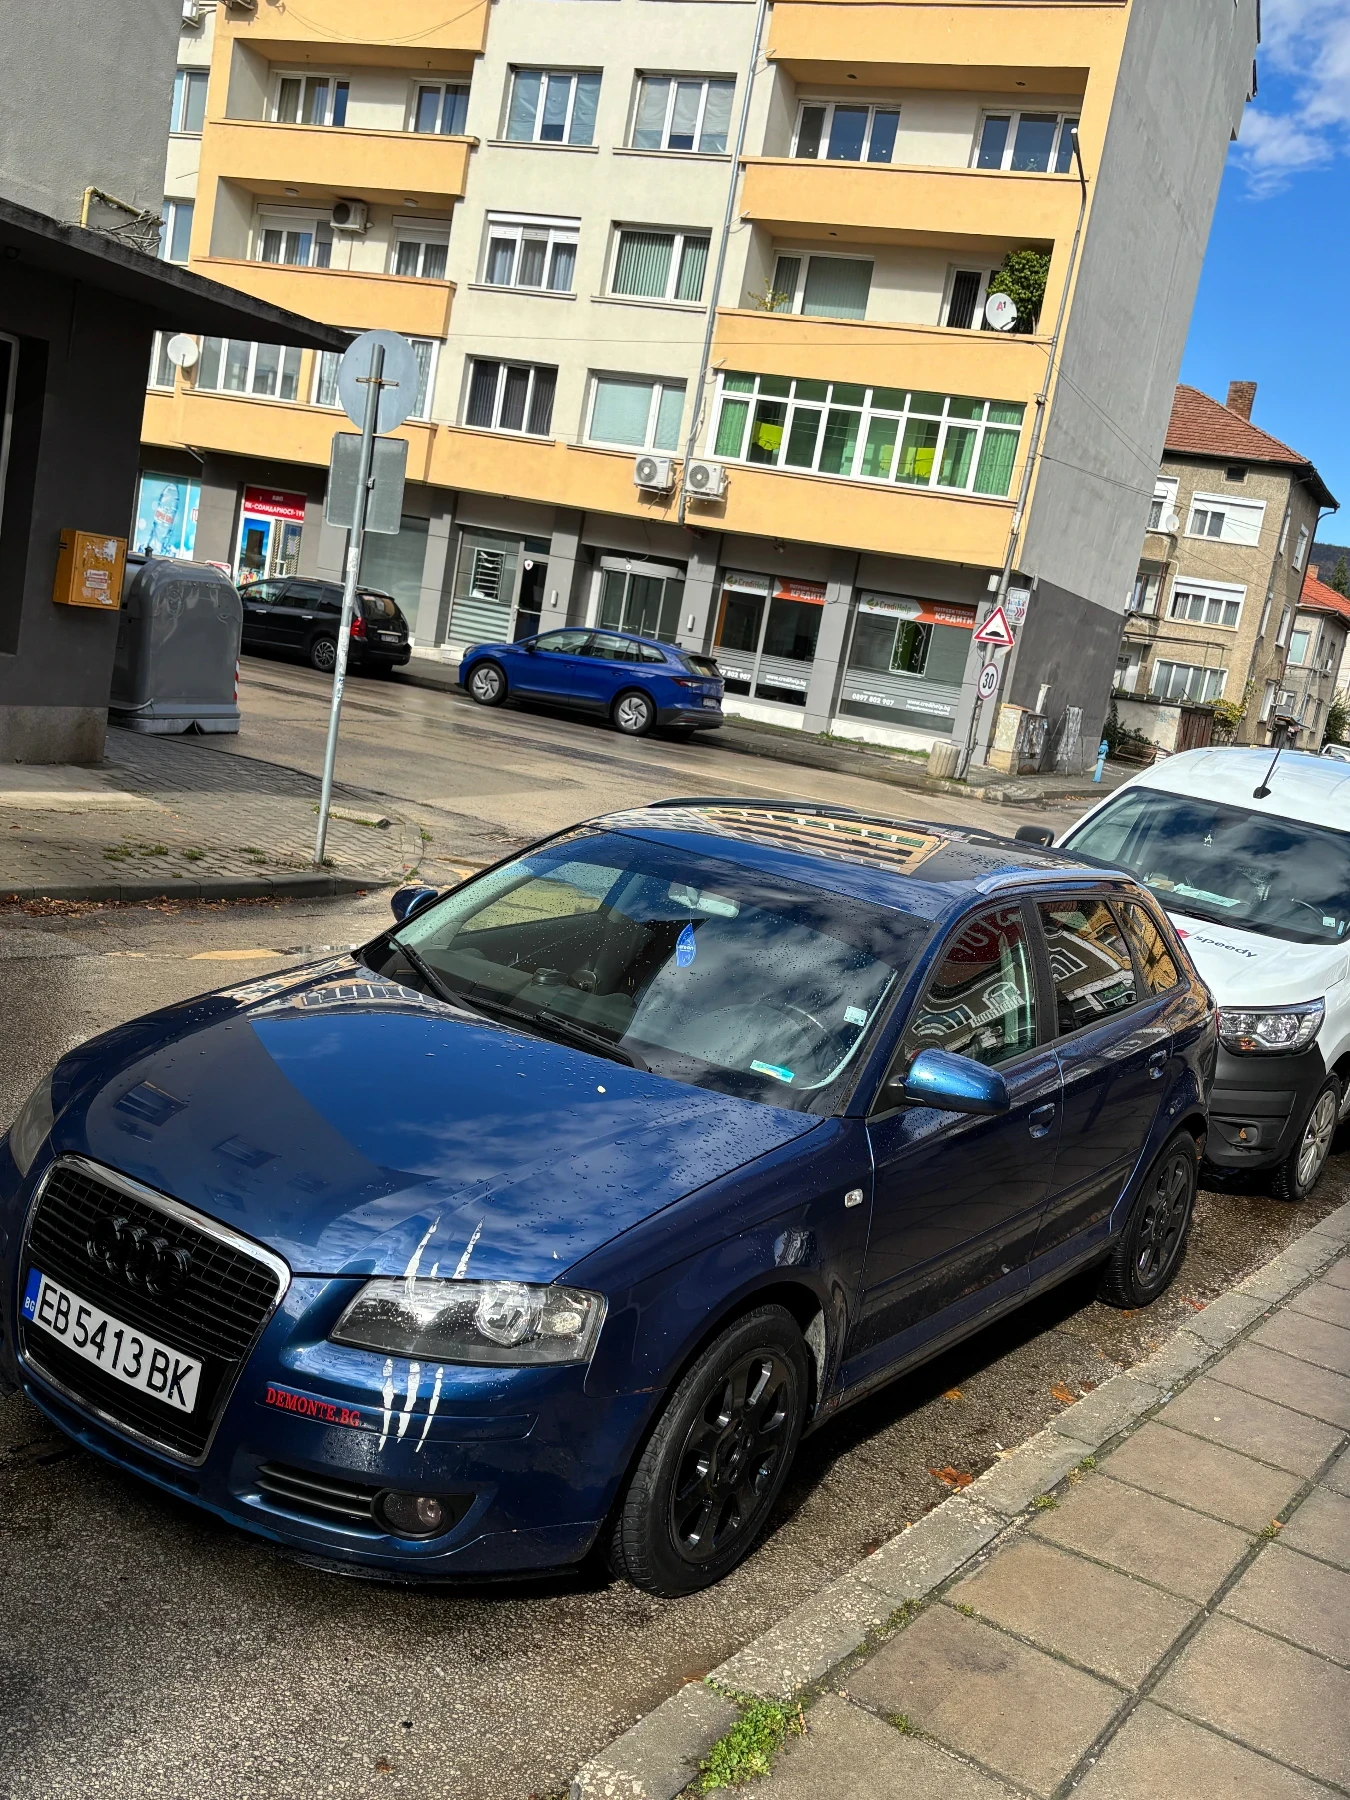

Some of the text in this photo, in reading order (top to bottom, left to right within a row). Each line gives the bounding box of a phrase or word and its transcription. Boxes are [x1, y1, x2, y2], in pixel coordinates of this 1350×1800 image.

[996, 301, 1007, 312] A1
[738, 579, 769, 592] CrediHelp
[879, 600, 912, 615] CrediHelp
[935, 612, 974, 625] КРЕДИТИ
[982, 672, 995, 689] 30
[1194, 935, 1257, 958] speedy
[24, 1297, 36, 1312] BG
[265, 1387, 360, 1427] DEMONTE.BG
